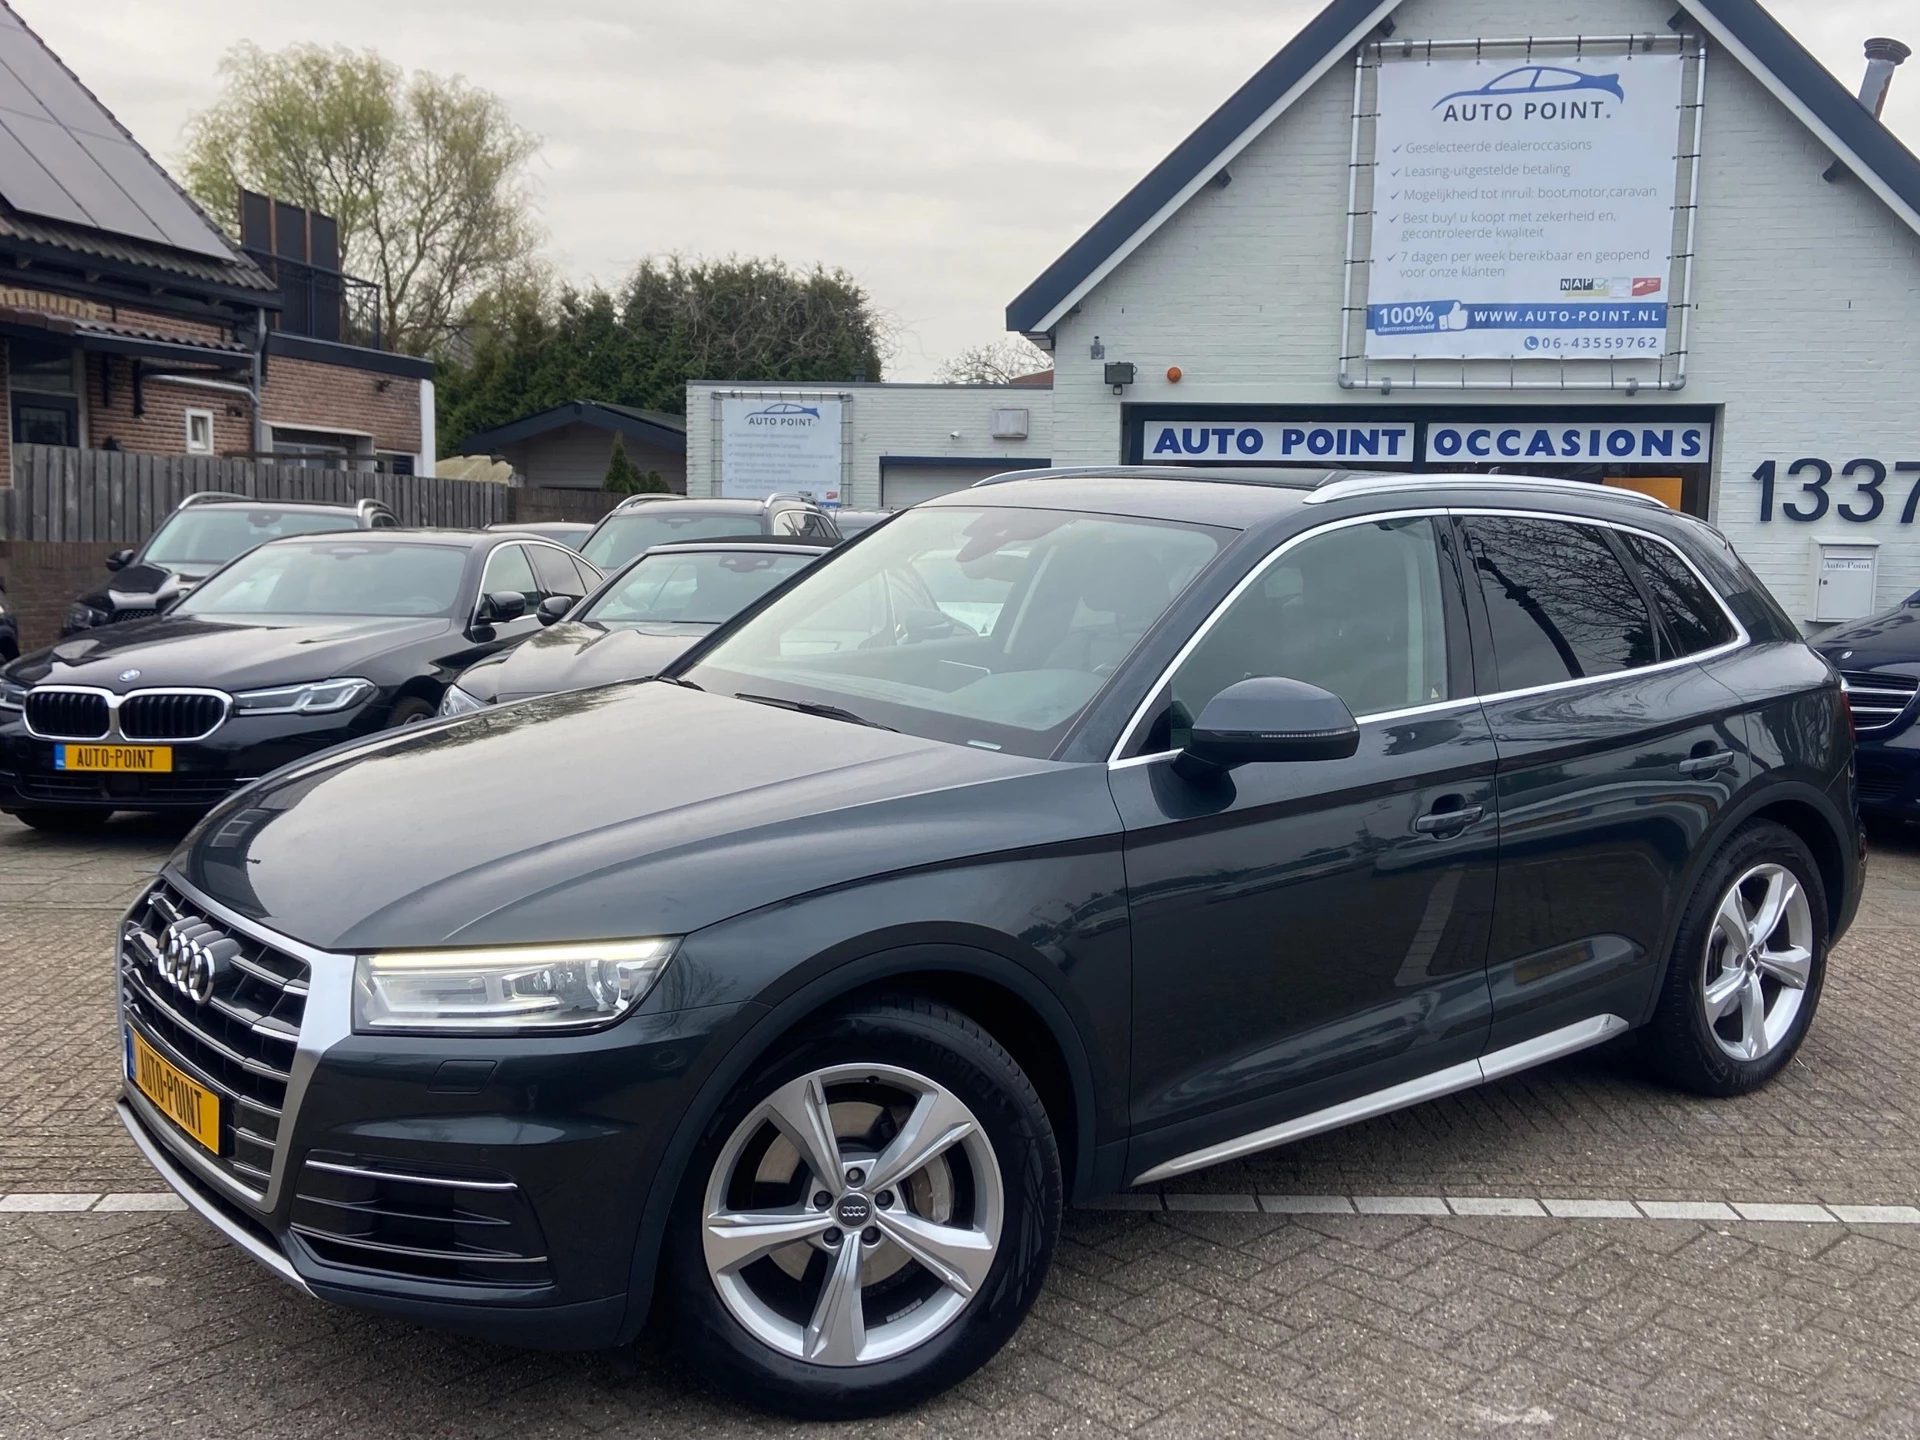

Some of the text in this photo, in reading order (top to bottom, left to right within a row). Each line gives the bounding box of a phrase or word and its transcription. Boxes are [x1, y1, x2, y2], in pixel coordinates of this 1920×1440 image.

[1443, 103, 1513, 122] AUTO
[1405, 139, 1592, 154] Geselecteerde dealeroccasions
[1522, 163, 1571, 178] betaling
[1403, 188, 1478, 203] Mogelijkheid
[1481, 189, 1498, 200] tot
[1501, 187, 1534, 200] inruil:
[1402, 212, 1428, 224] Best
[1432, 211, 1457, 226] buy!
[1460, 214, 1468, 224] u
[1471, 211, 1505, 226] koopt
[1508, 213, 1532, 223] met
[1535, 210, 1595, 222] zekerheid
[1401, 227, 1544, 242] gecontroleerde kwaliteit
[1401, 248, 1650, 265] 7 dagen per week bereikbaar en geopend
[1399, 265, 1505, 278] voor onze klanten
[1560, 278, 1594, 291] NAP
[1379, 305, 1434, 325] 100%
[1474, 309, 1660, 323] WWW.AUTO-POINT.NL
[1542, 336, 1658, 349] 06-43559762
[748, 417, 777, 426] AUTO
[1153, 428, 1406, 456] AUTO POINT
[1433, 429, 1702, 457] OCCASIONS
[1824, 558, 1871, 570] Auto-Point
[76, 747, 155, 769] AUTO-POINT
[140, 1044, 202, 1135] AUTO-POINT
